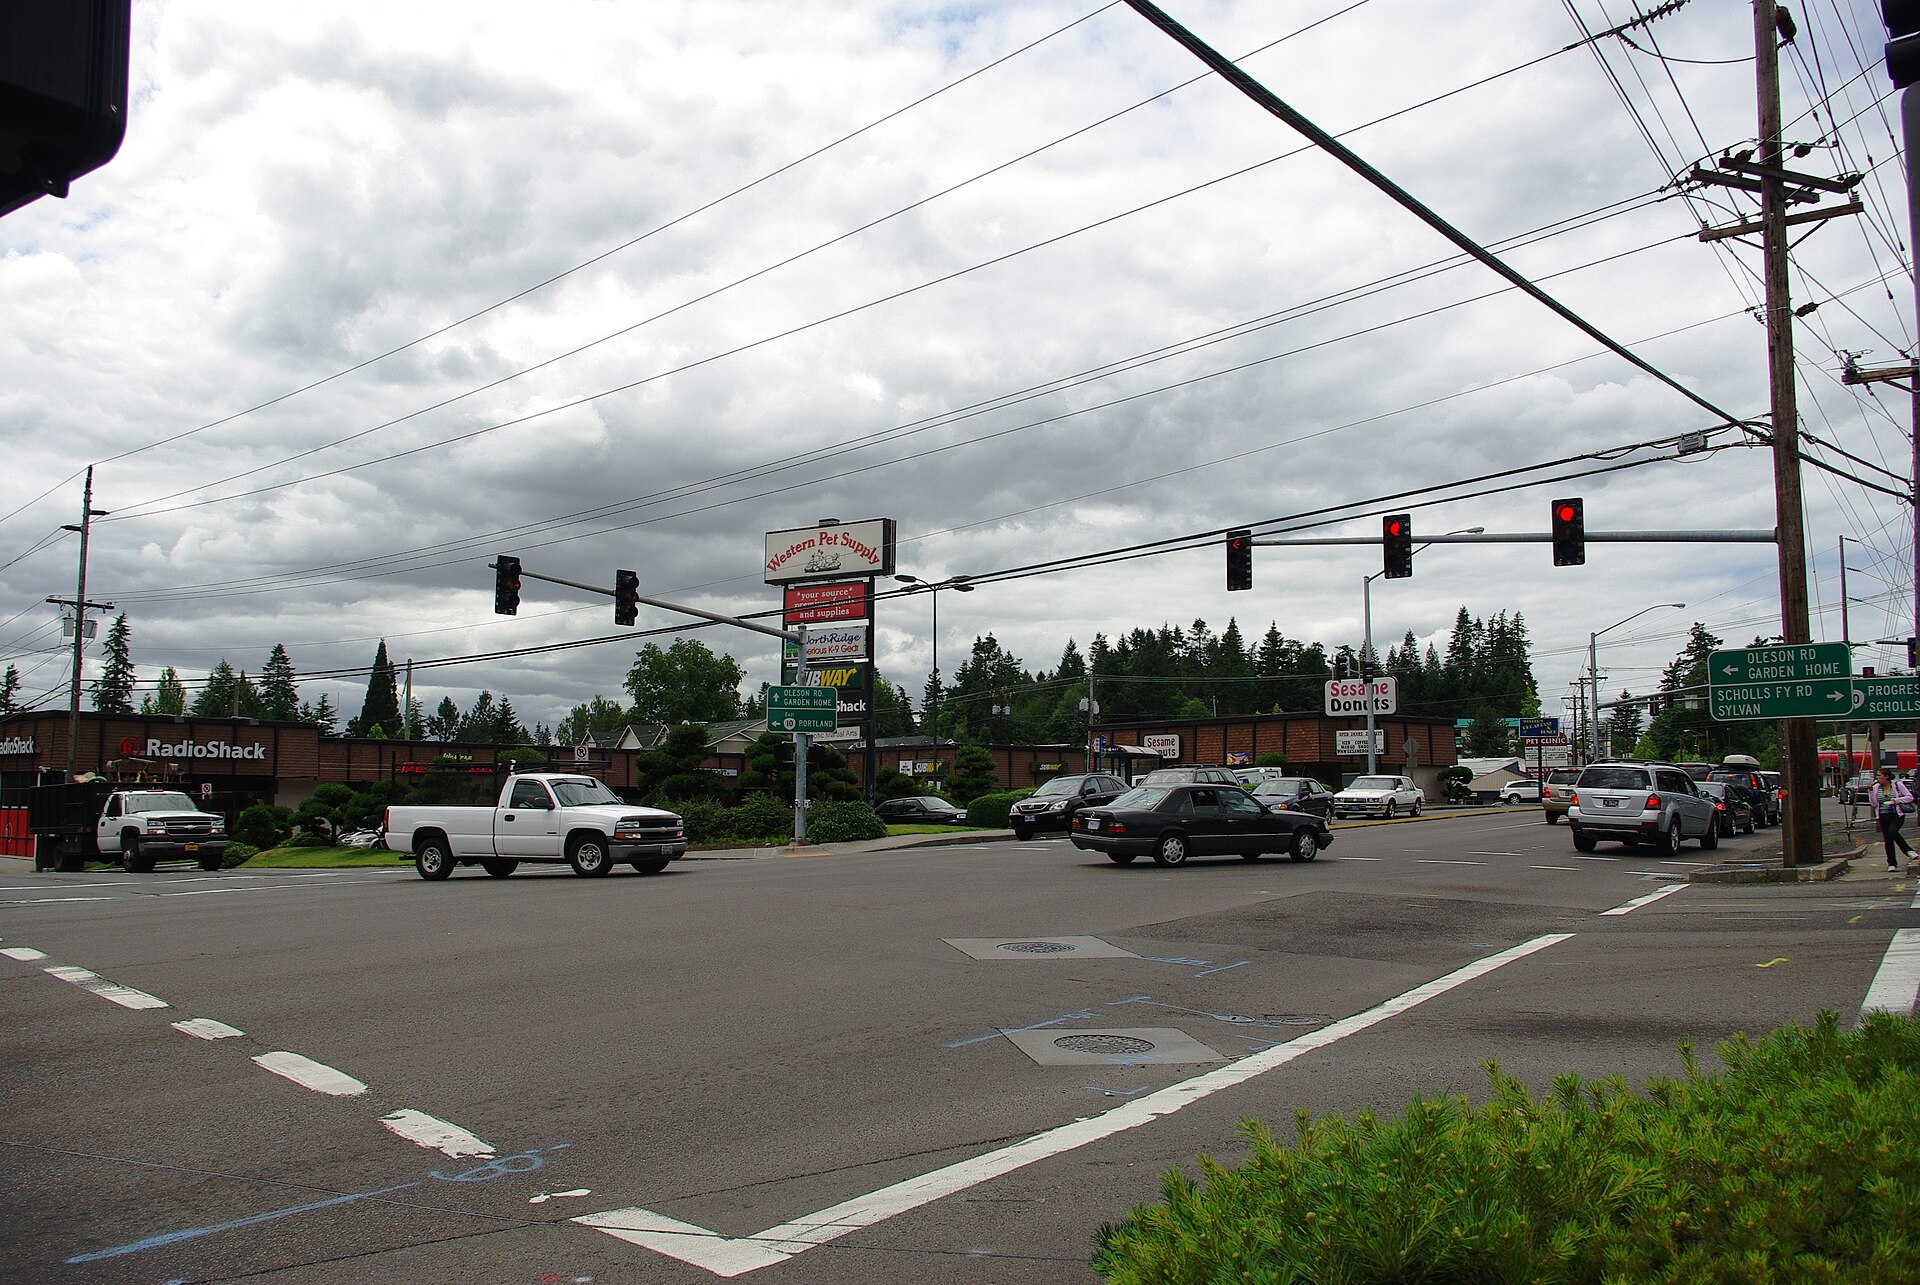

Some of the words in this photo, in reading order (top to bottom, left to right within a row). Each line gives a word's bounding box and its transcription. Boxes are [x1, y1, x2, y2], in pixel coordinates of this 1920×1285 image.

[767, 538, 816, 572] Western
[818, 531, 838, 546] Pet
[840, 531, 880, 565] Supply
[799, 610, 815, 619] and
[817, 607, 850, 618] supplies
[806, 646, 828, 655] erious
[1747, 650, 1795, 664] OLESON
[1800, 648, 1816, 660] RD
[1748, 665, 1795, 679] GARDEN
[1805, 662, 1841, 676] HOME
[784, 689, 810, 697] OLESON
[1717, 687, 1771, 702] SCHOLLS
[1775, 686, 1791, 698] FY
[1796, 685, 1813, 697] RD
[783, 698, 810, 706] GARDEN
[1869, 700, 1920, 713] SCHOLLS
[1718, 703, 1761, 717] SYLVAN
[799, 719, 834, 728] PORTLAND
[146, 738, 267, 760] RadioShack
[1147, 737, 1176, 748] Sesame
